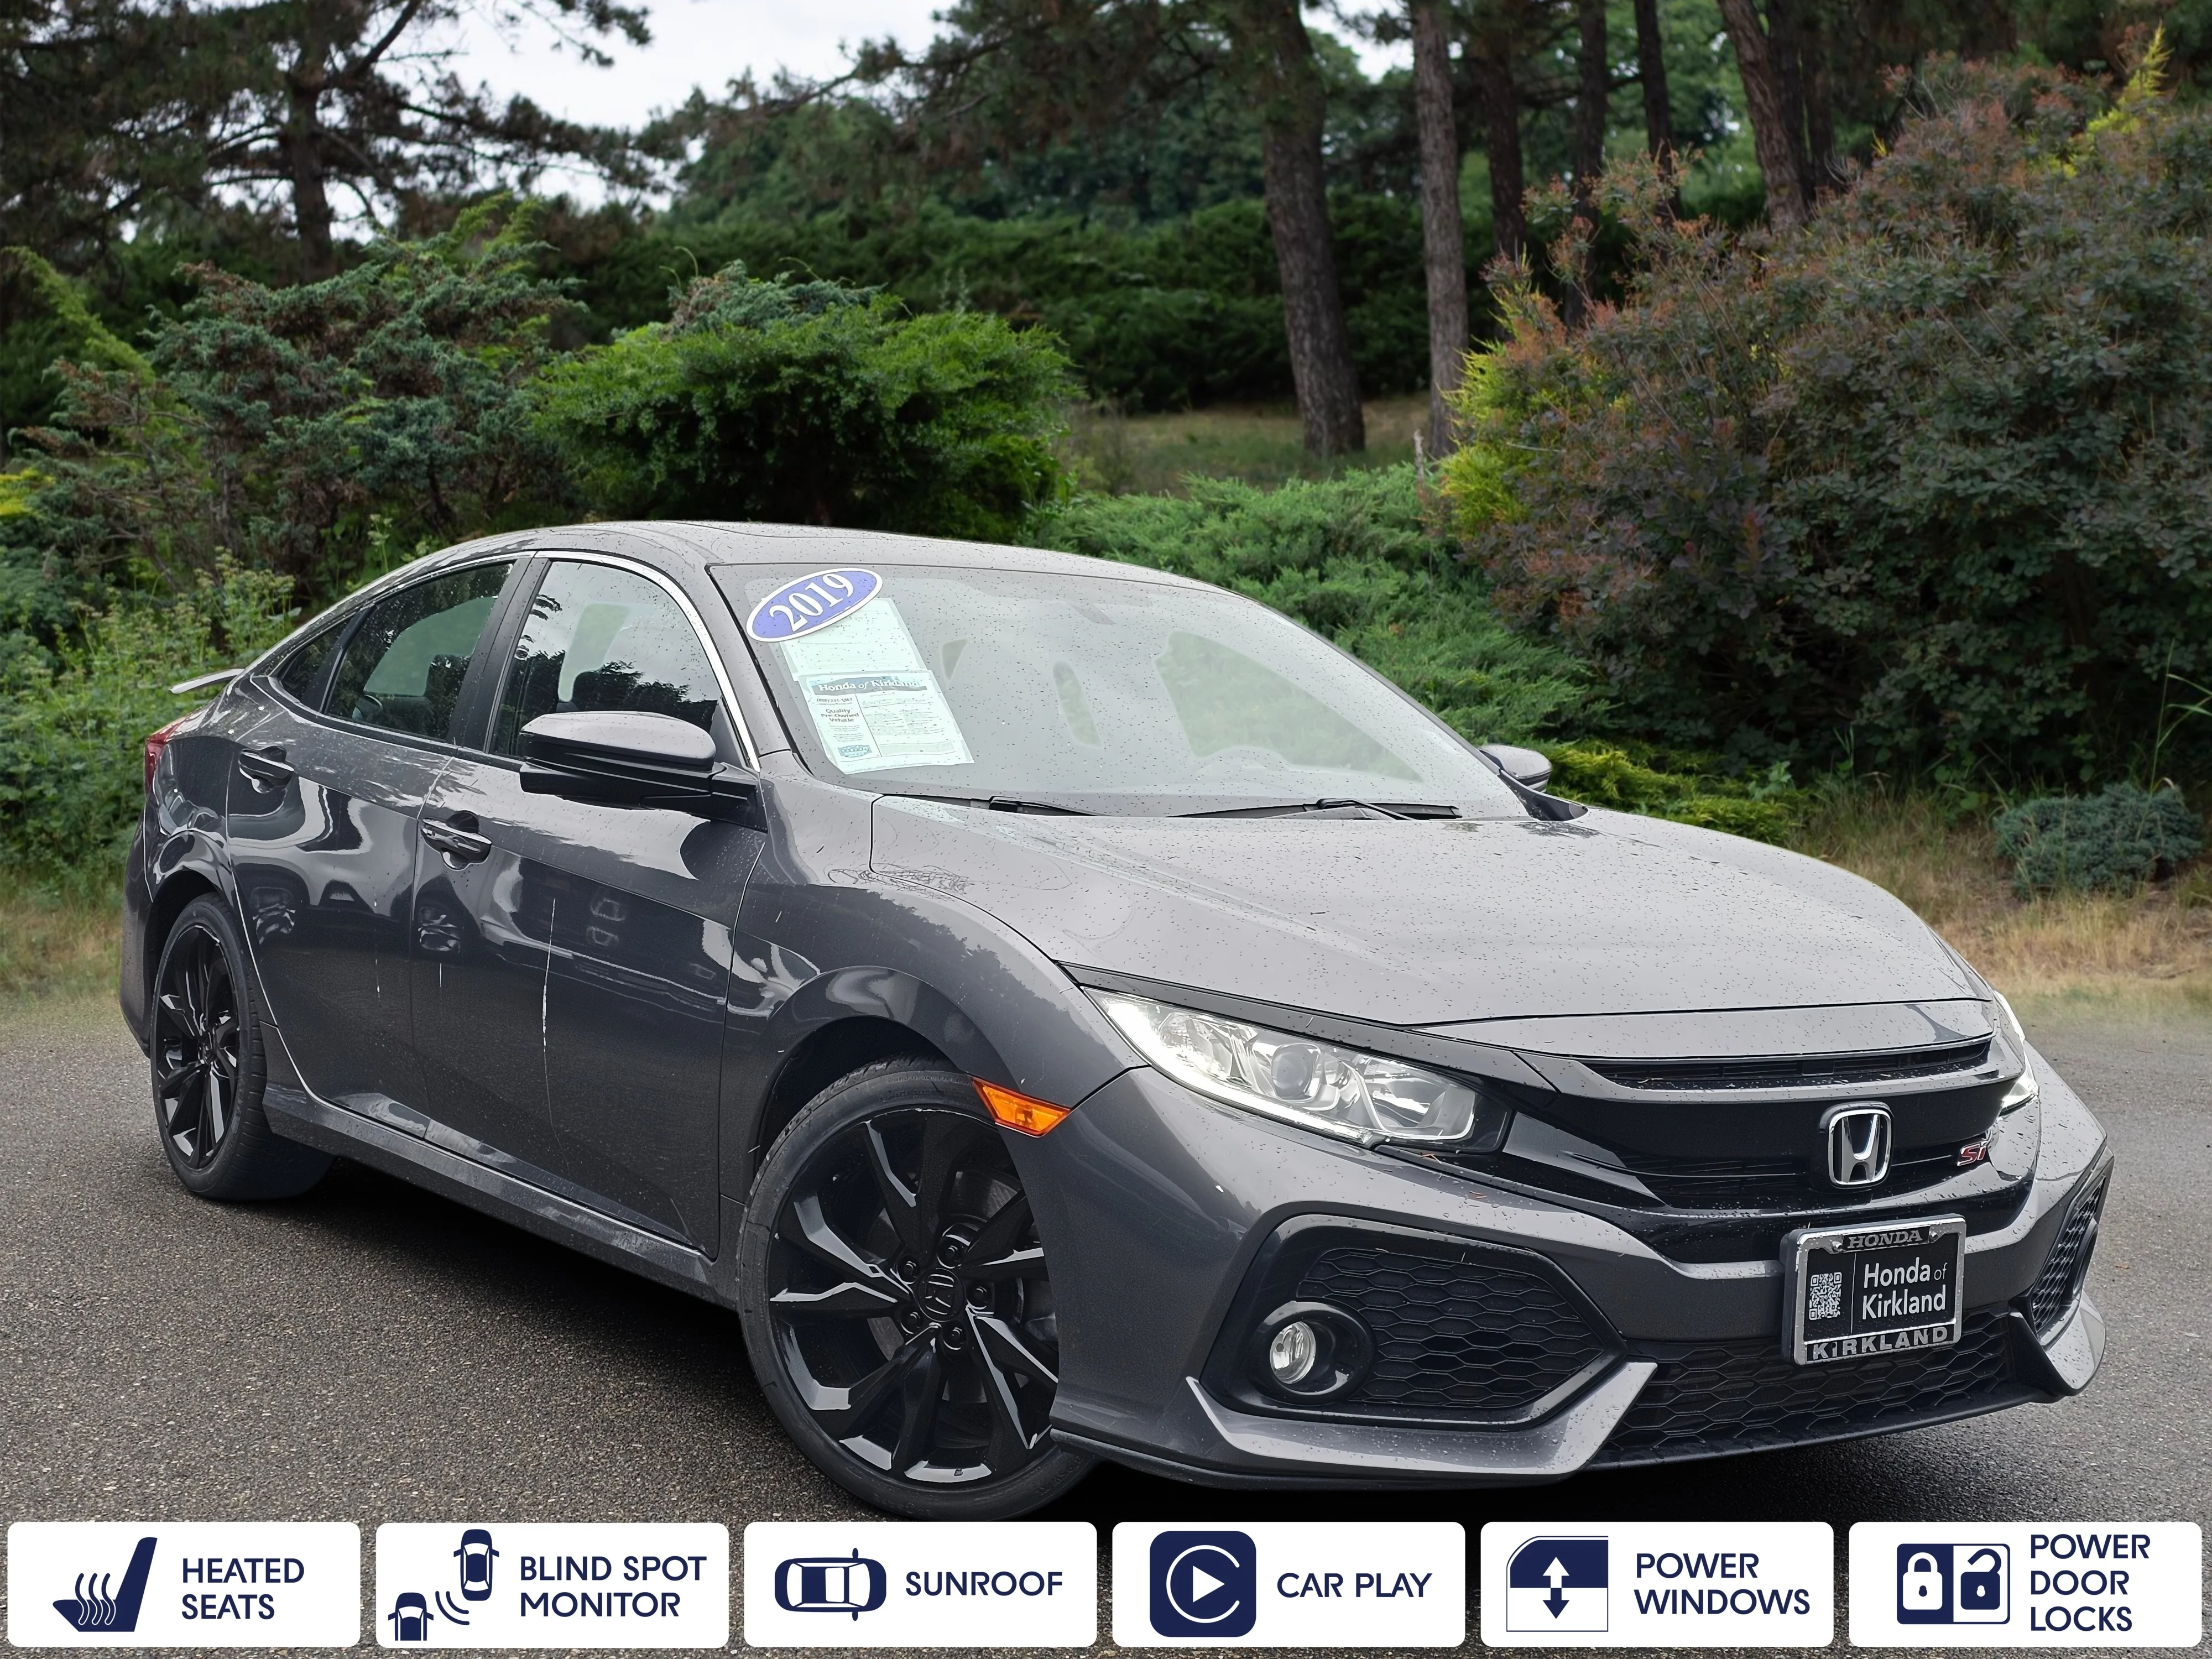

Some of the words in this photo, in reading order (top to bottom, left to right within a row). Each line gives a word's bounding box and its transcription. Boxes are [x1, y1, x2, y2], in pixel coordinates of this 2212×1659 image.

[769, 573, 854, 633] 2019
[818, 682, 857, 692] Honda
[858, 681, 869, 690] of
[870, 679, 921, 687] Kirkland
[1848, 1229, 1923, 1250] HONDA
[1864, 1257, 1931, 1288] Honda
[1934, 1262, 1948, 1281] of
[1862, 1284, 1947, 1320] Kirkland
[1812, 1326, 1948, 1360] KIRKLAND
